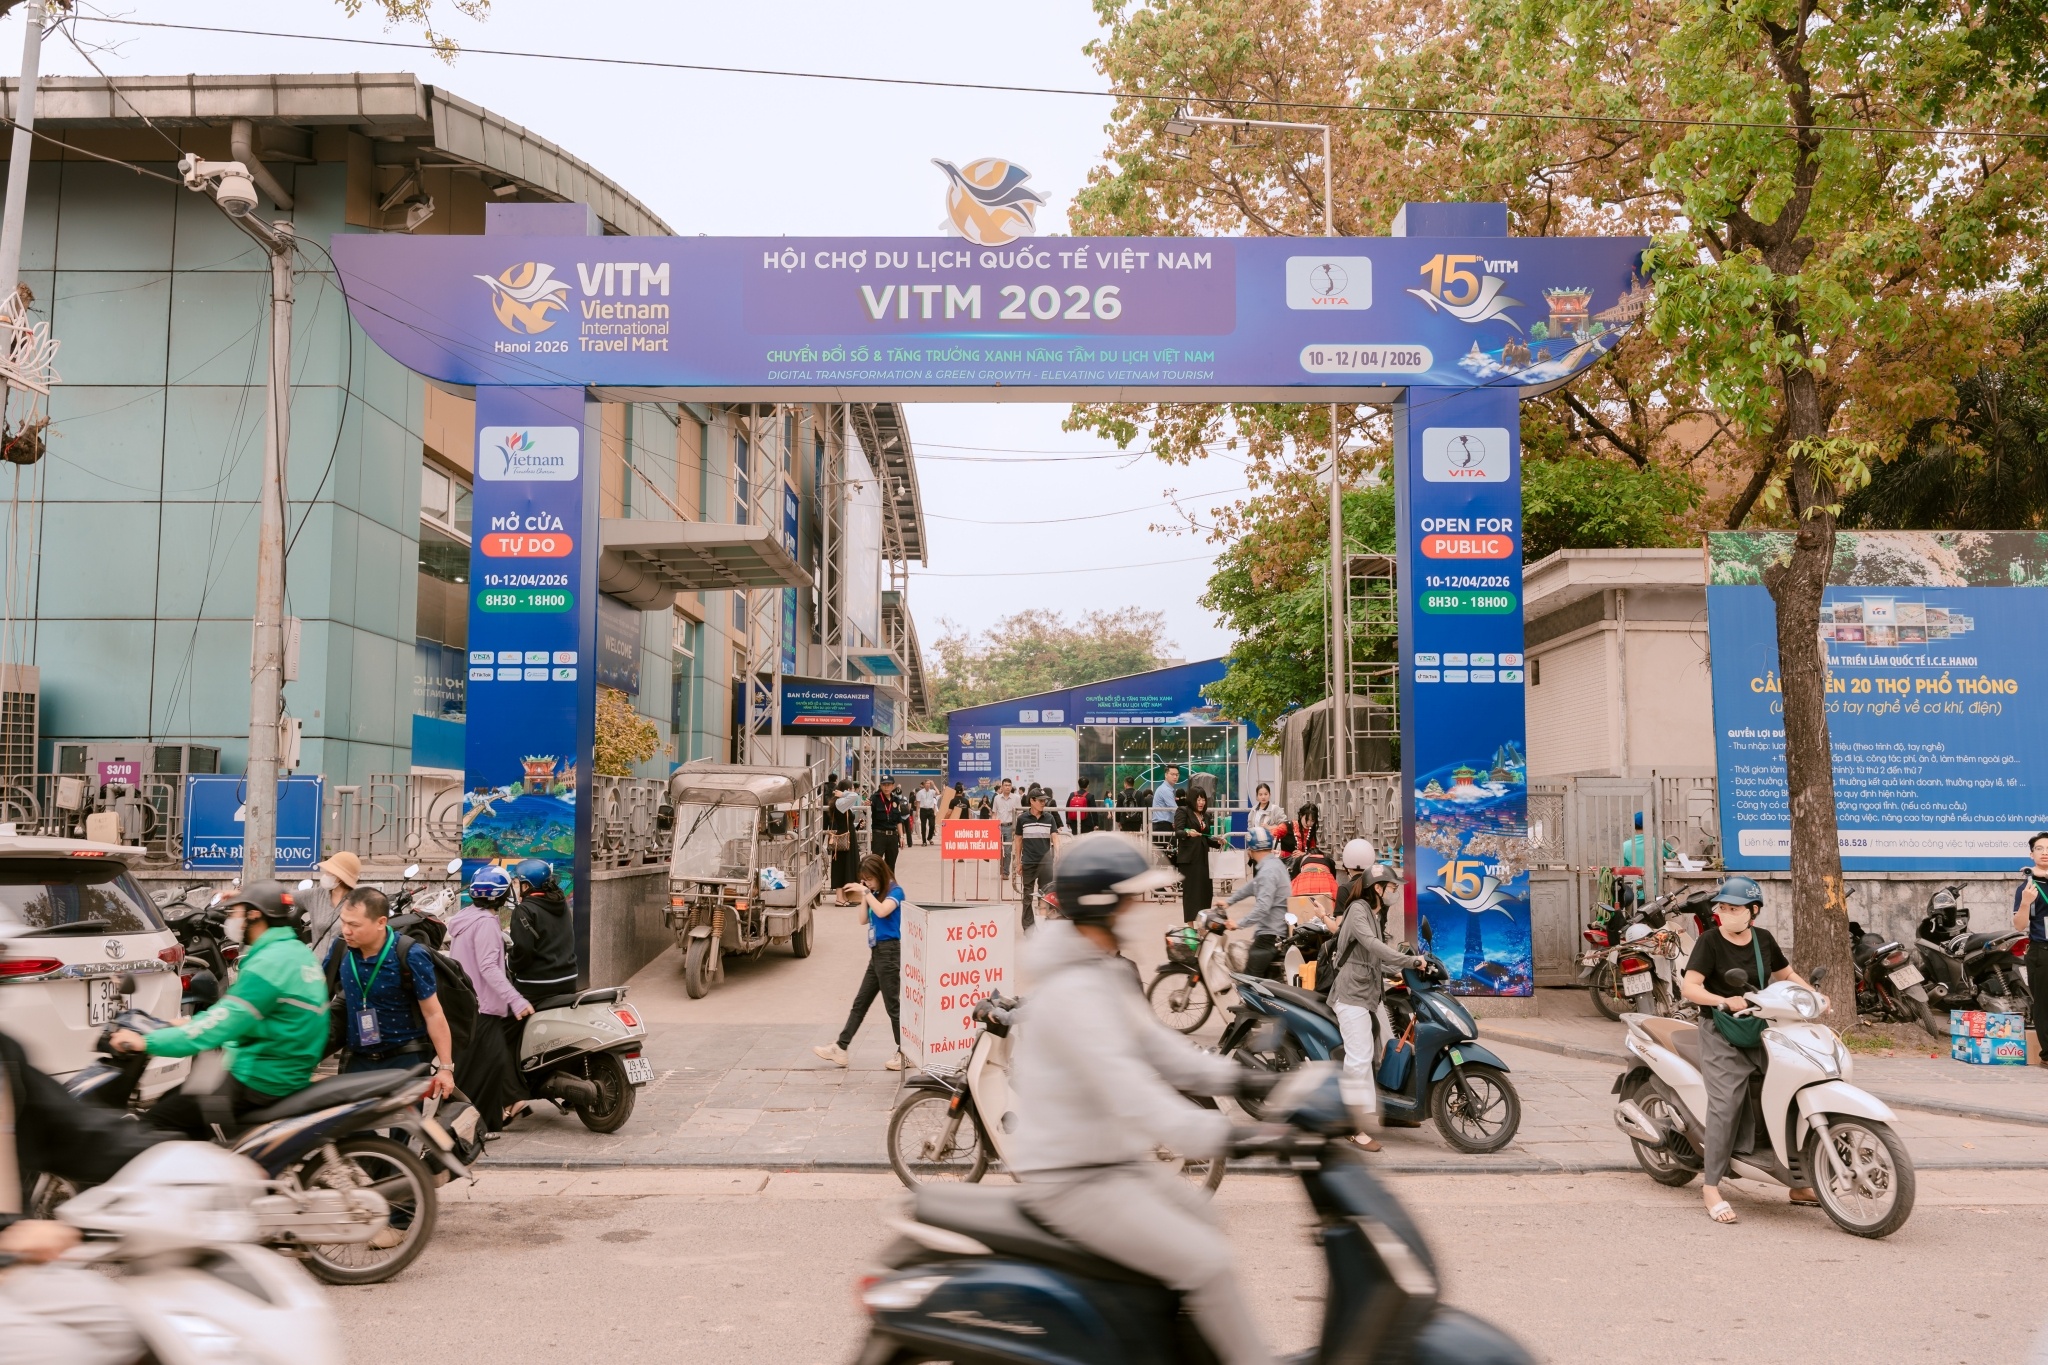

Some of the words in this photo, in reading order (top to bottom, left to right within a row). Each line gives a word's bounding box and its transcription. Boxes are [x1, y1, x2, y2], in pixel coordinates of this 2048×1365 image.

[763, 246, 806, 273] HỘI
[814, 249, 867, 273] CHỢ
[875, 251, 909, 269] DU
[916, 250, 971, 273] LỊCH
[979, 244, 1051, 269] QUỐC
[1058, 244, 1090, 269] TẾ
[1095, 247, 1150, 274] VIỆT
[1157, 251, 1212, 270] NAM
[1484, 260, 1519, 274] VITM
[576, 262, 670, 297] VITM
[860, 284, 982, 320] VITM
[998, 284, 1122, 321] 2026
[1311, 297, 1349, 305] VITA
[580, 299, 670, 319] Vietnam
[581, 320, 669, 335] International
[494, 340, 531, 353] Hanoi
[534, 340, 569, 353] 2026
[578, 336, 628, 352] Travel
[631, 337, 669, 352] Mart
[766, 344, 818, 363] CHUYỂN
[821, 344, 846, 363] ĐỔI
[850, 345, 869, 362] SỐ
[873, 350, 883, 362] &
[887, 347, 921, 362] TĂNG
[926, 346, 980, 362] TRƯỞNG
[984, 350, 1022, 362] XANH
[1026, 347, 1063, 363] NÂNG
[1067, 346, 1095, 362] TẦM
[1100, 350, 1118, 362] DU
[1122, 350, 1149, 365] LỊCH
[1152, 347, 1181, 365] VIỆT
[1184, 350, 1215, 363] NAM
[1308, 351, 1324, 366] 10
[1336, 351, 1349, 366] 12
[1360, 351, 1379, 366] 04
[1389, 351, 1422, 366] 2026
[767, 370, 813, 380] DIGITAL
[815, 370, 923, 380] TRANSFORMATION
[924, 370, 933, 379] &
[935, 370, 976, 380] GREEN
[978, 370, 1031, 380] GROWTH
[1041, 370, 1105, 380] ELEVATING
[1107, 370, 1160, 380] VIETNAM
[1162, 370, 1214, 380] TOURISM
[494, 444, 564, 477] Vietnam
[1448, 469, 1486, 477] VITA
[491, 511, 520, 531] MỞ
[525, 511, 564, 531] CỬA
[1420, 517, 1470, 532] OPEN
[1476, 518, 1513, 532] FOR
[498, 537, 523, 556] TỰ
[528, 538, 555, 553] DO
[1435, 539, 1499, 554] PUBLIC
[484, 573, 568, 587] 10-12/04/2026
[1425, 575, 1510, 588] 10-12/04/2026
[485, 594, 517, 607] 8H30
[527, 594, 565, 607] 18H00
[1428, 596, 1459, 608] 8H30
[1470, 596, 1508, 608] 18H00
[604, 634, 633, 660] WELCOME
[1841, 653, 1867, 666] TRIỂN
[1889, 653, 1914, 667] QUỐC
[1915, 653, 1926, 666] TẾ
[1927, 656, 1978, 666] I.C.E.HANOI
[1850, 678, 1871, 694] 20
[1875, 677, 1911, 697] THỢ
[1915, 670, 1952, 694] PHỔ
[1956, 675, 2019, 694] THÔNG
[1843, 702, 1863, 718] tay
[1866, 698, 1901, 718] nghề
[1904, 699, 1920, 713] về
[1923, 703, 1941, 714] cơ
[1944, 700, 1964, 715] khí,
[1968, 701, 2003, 717] điện)
[974, 732, 990, 740] VITM
[106, 764, 132, 775] S3/10
[981, 829, 989, 839] XE
[275, 847, 312, 862] RỌNG
[1484, 865, 1510, 875] VITM
[946, 926, 963, 942] XE
[966, 920, 998, 941] Ô-TÔ
[957, 944, 987, 963] VÀO
[939, 970, 981, 988] CUNG
[985, 967, 1003, 982] VH
[940, 995, 955, 1011] ĐI
[930, 1034, 955, 1054] TRẦN
[1997, 1046, 2024, 1056] laVie
